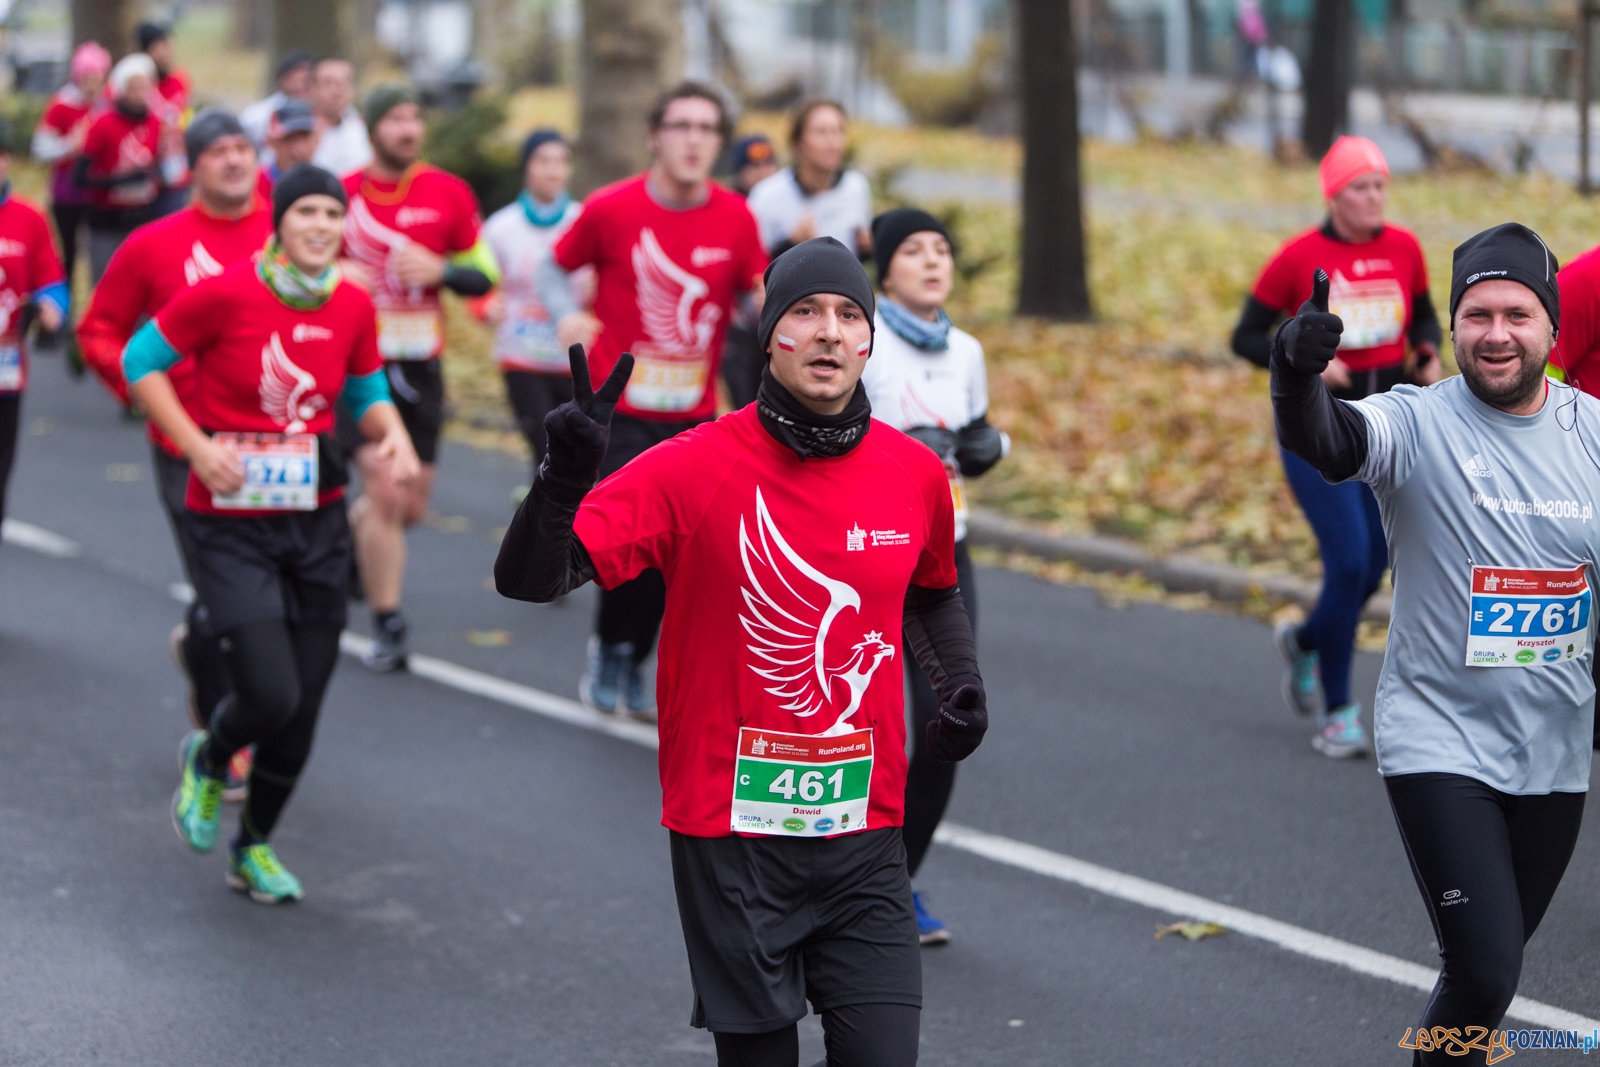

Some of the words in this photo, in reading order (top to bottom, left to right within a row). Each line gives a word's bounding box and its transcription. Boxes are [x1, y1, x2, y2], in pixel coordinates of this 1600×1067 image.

[1472, 492, 1593, 524] www.autoabc2006.pl
[1474, 611, 1483, 621] E
[1488, 599, 1581, 633] 2761
[1517, 639, 1556, 647] Krzysztof
[818, 743, 866, 755] RunPoland.org
[740, 774, 750, 785] C
[768, 768, 844, 802] 461
[792, 807, 821, 815] Dawid
[739, 815, 762, 823] GRUPA
[738, 821, 765, 829] LUXMED
